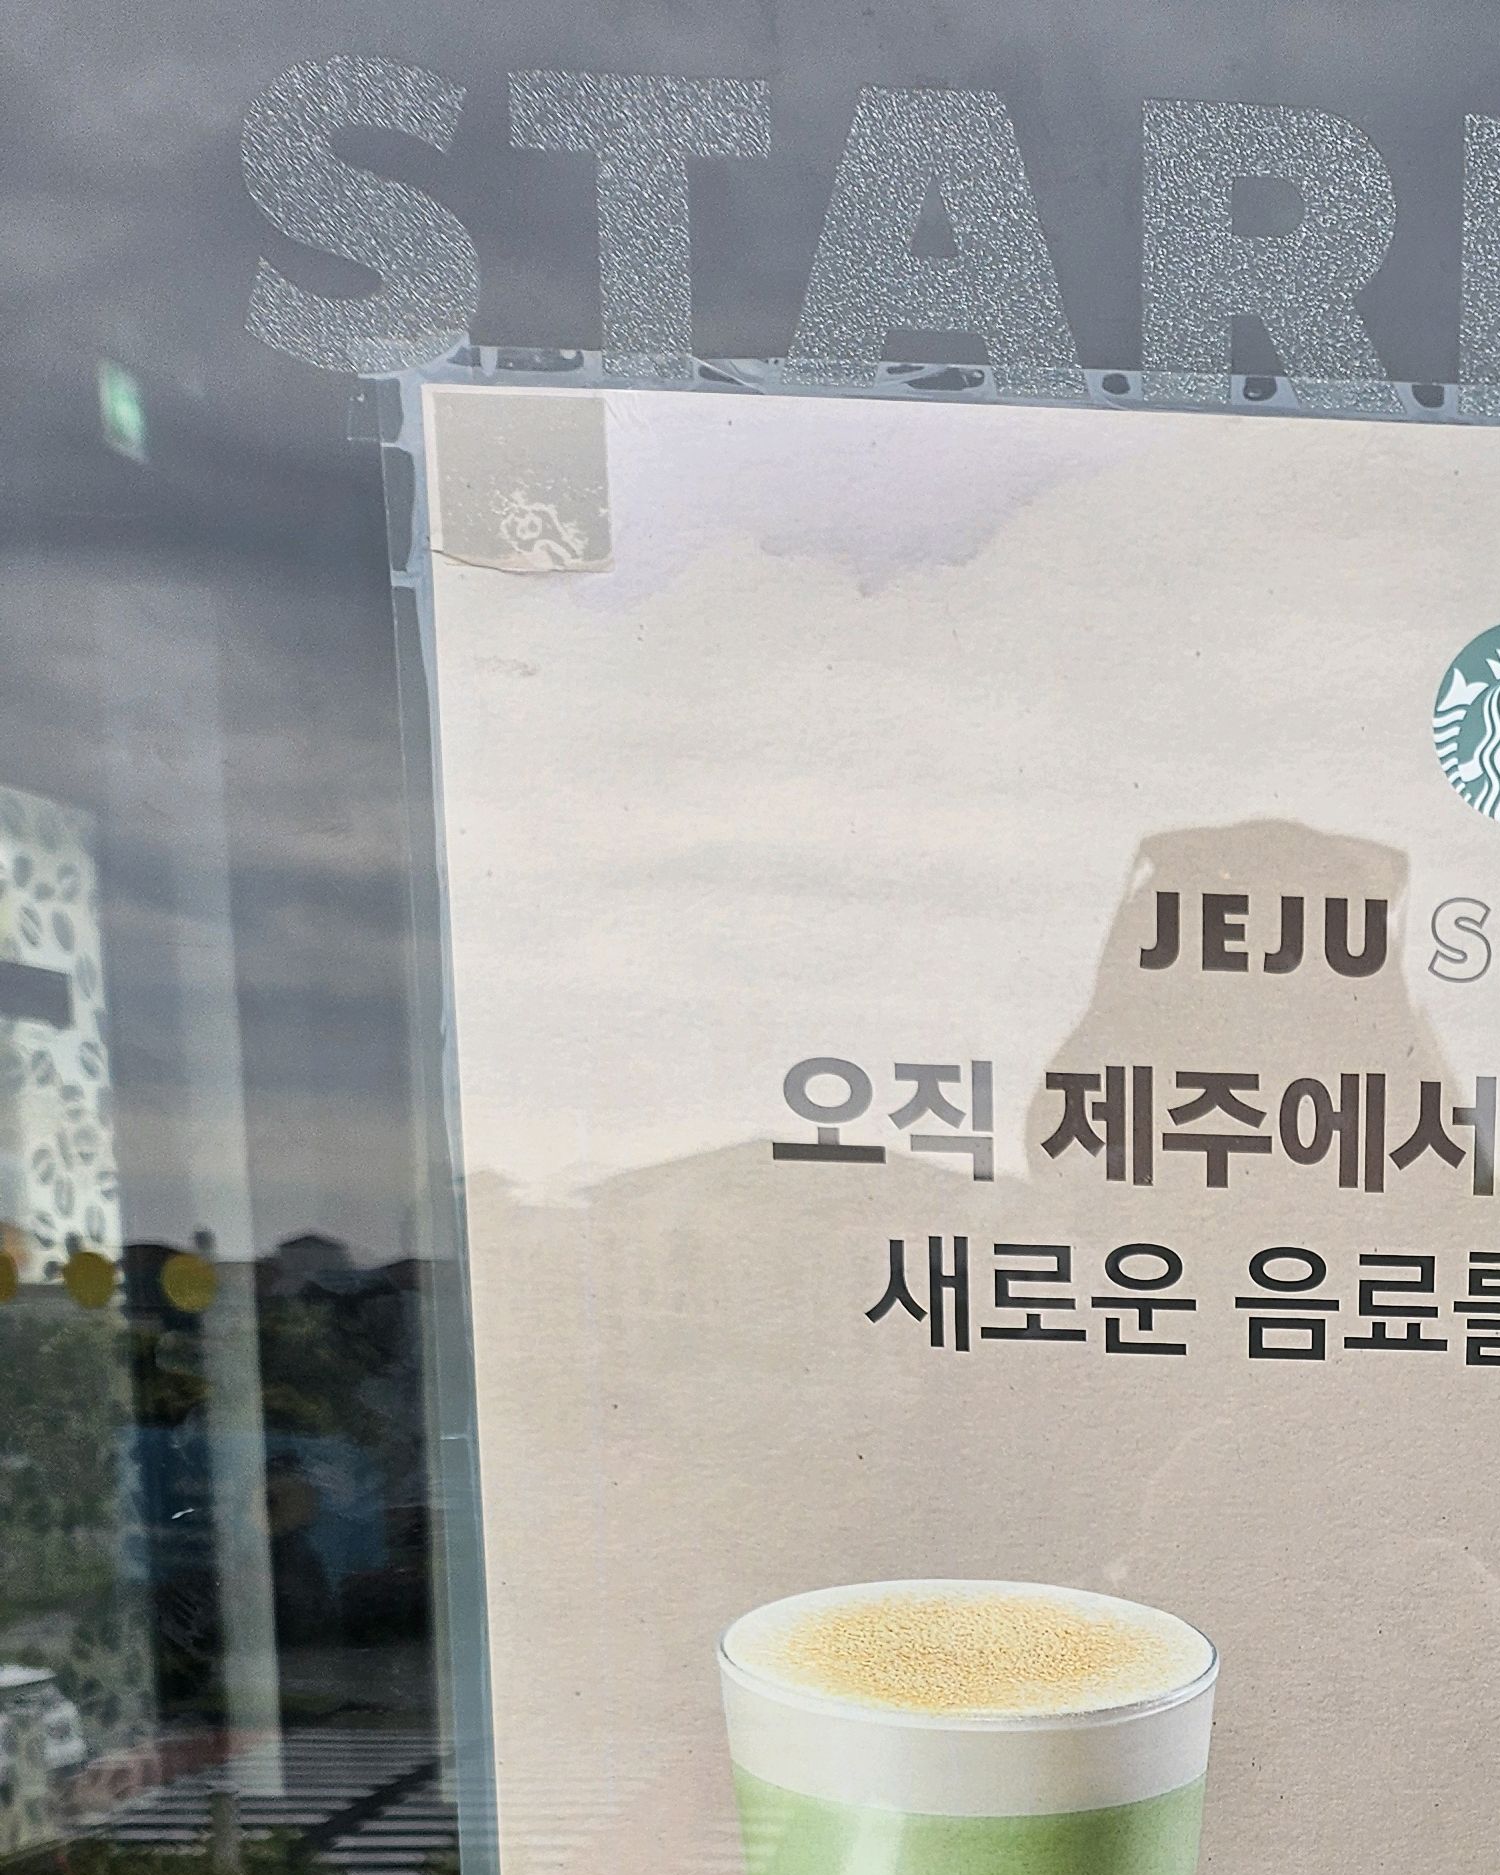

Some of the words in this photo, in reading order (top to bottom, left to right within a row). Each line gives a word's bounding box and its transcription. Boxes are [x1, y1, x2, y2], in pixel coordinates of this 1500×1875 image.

[1140, 892, 1388, 977] JEJU
[772, 1057, 995, 1181] 오직
[865, 1235, 1197, 1355] 새로운
